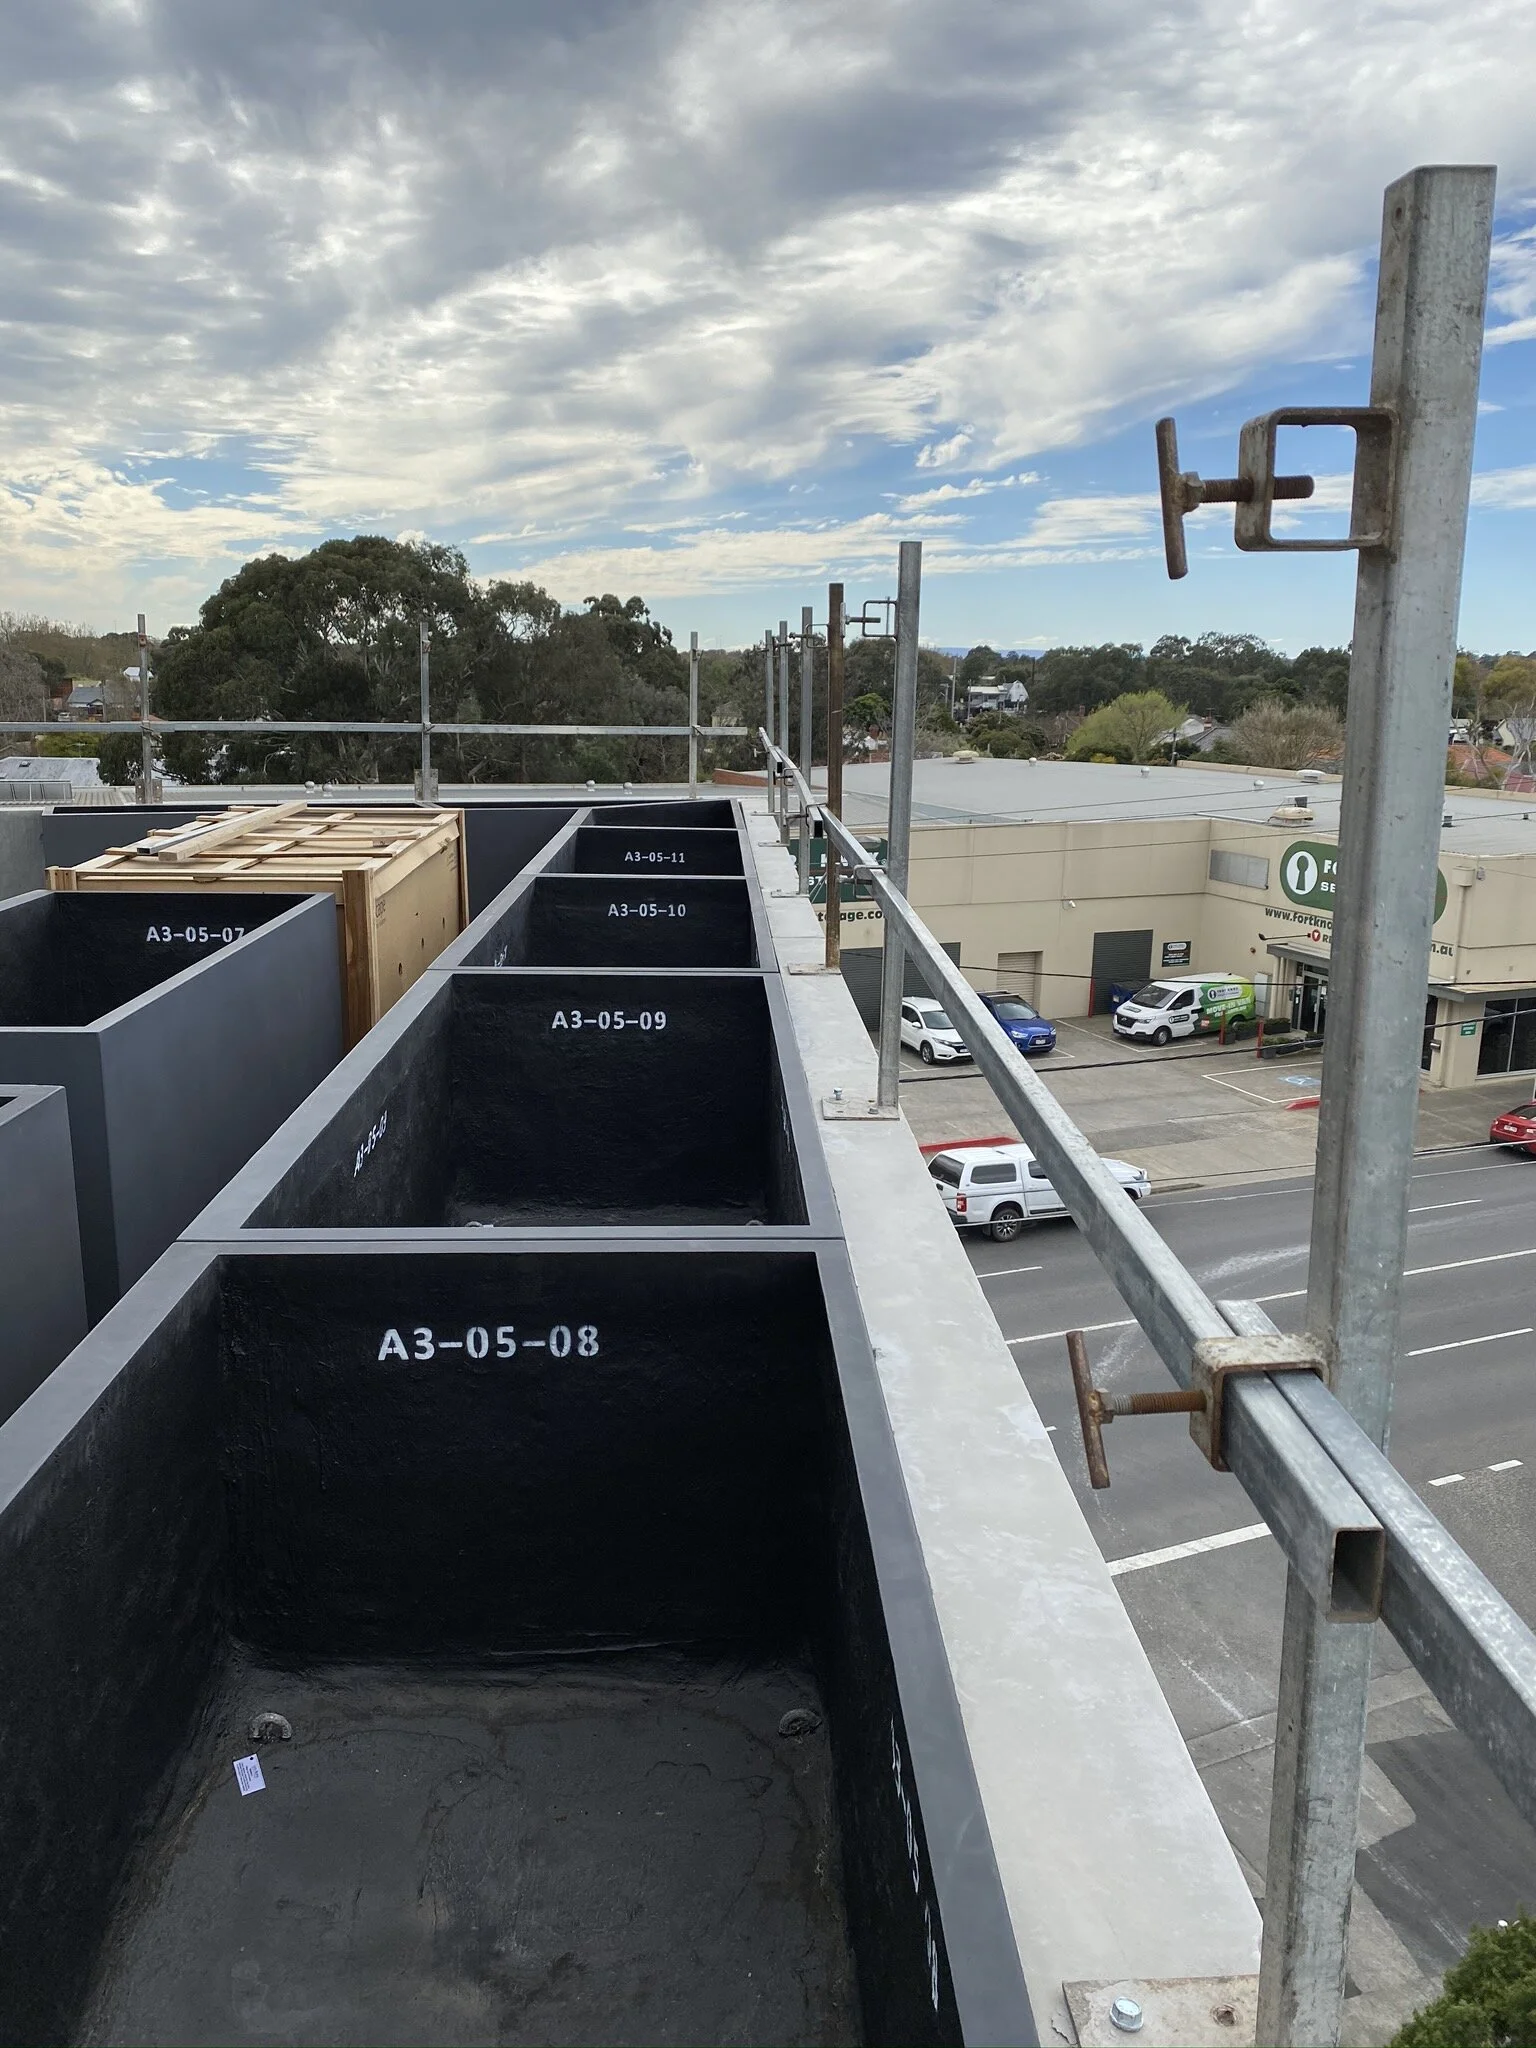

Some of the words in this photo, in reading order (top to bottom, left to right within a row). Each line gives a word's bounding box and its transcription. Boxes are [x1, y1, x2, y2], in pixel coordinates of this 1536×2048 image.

[624, 851, 685, 863] A3-05-11
[607, 903, 687, 917] A3-05-10
[551, 1010, 667, 1030] A3-05-09
[377, 1324, 599, 1361] A3-05-08
